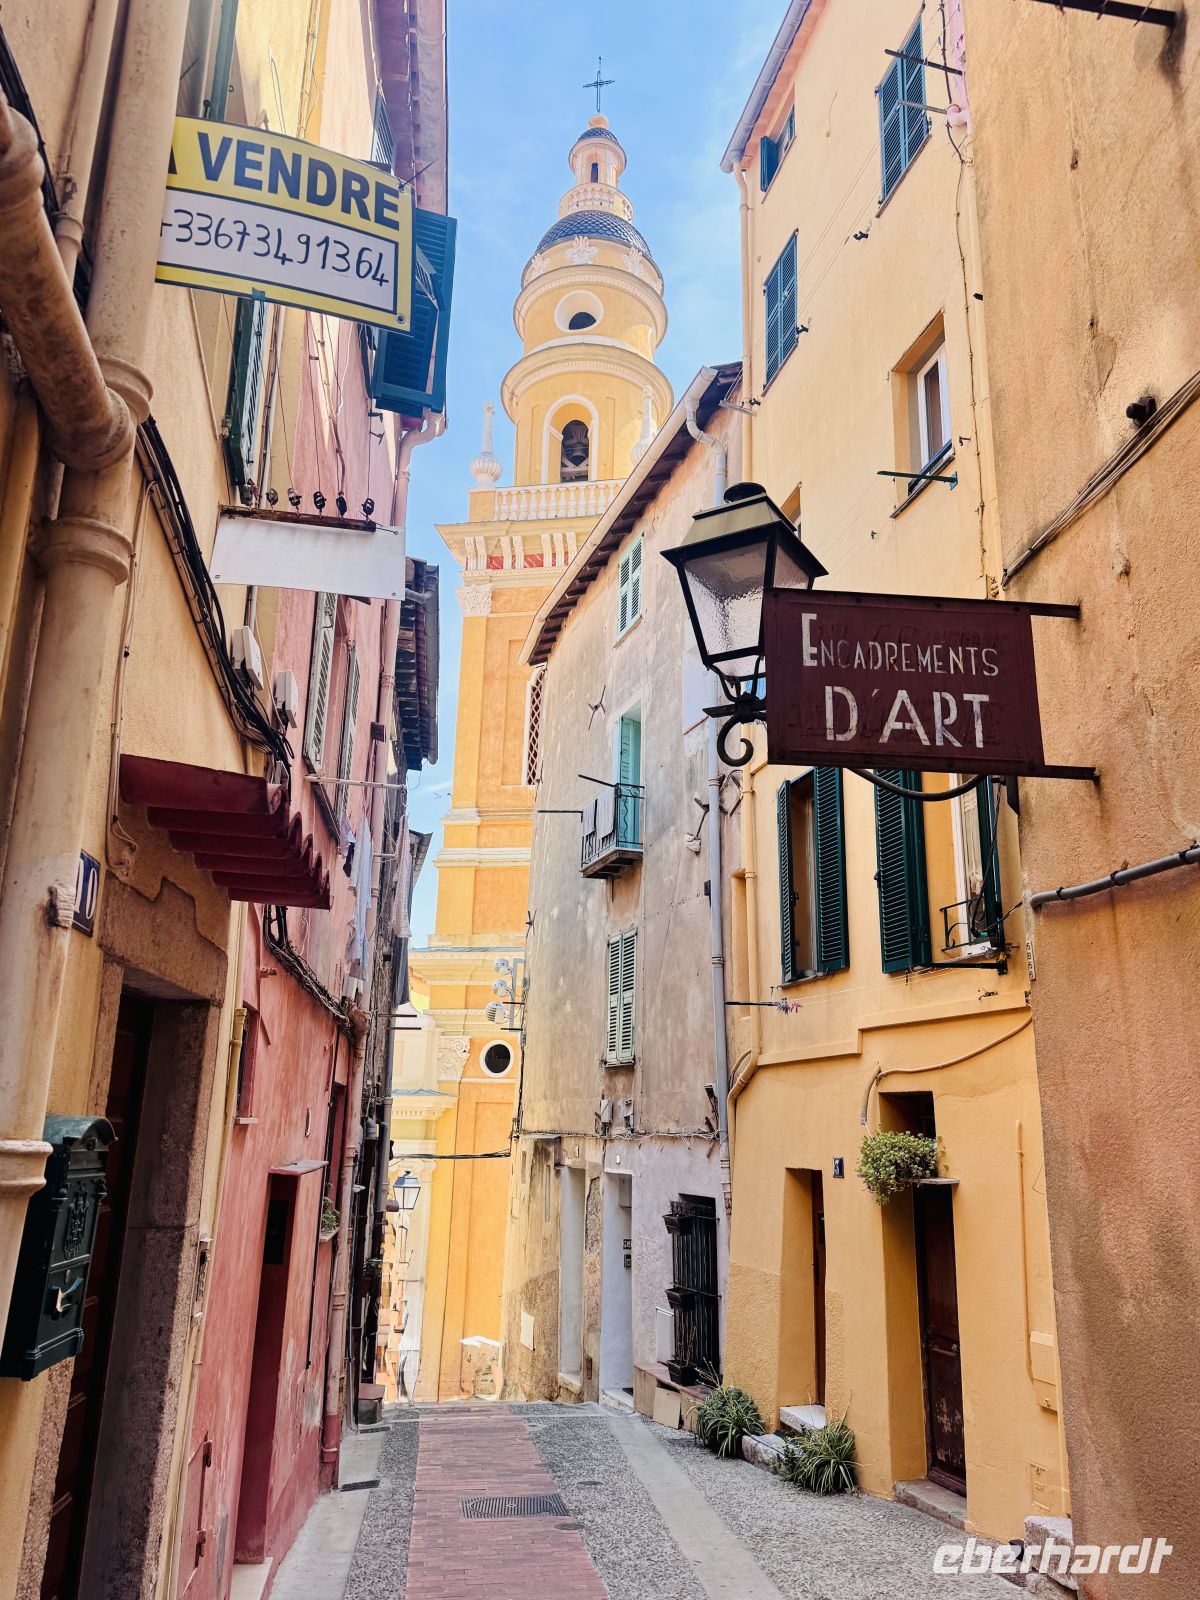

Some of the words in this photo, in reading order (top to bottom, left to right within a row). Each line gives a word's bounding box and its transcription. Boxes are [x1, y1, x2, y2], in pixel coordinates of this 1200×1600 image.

[197, 131, 400, 231] VENDRE
[801, 612, 999, 677] ENCADREMENTS
[824, 685, 990, 748] D'ART
